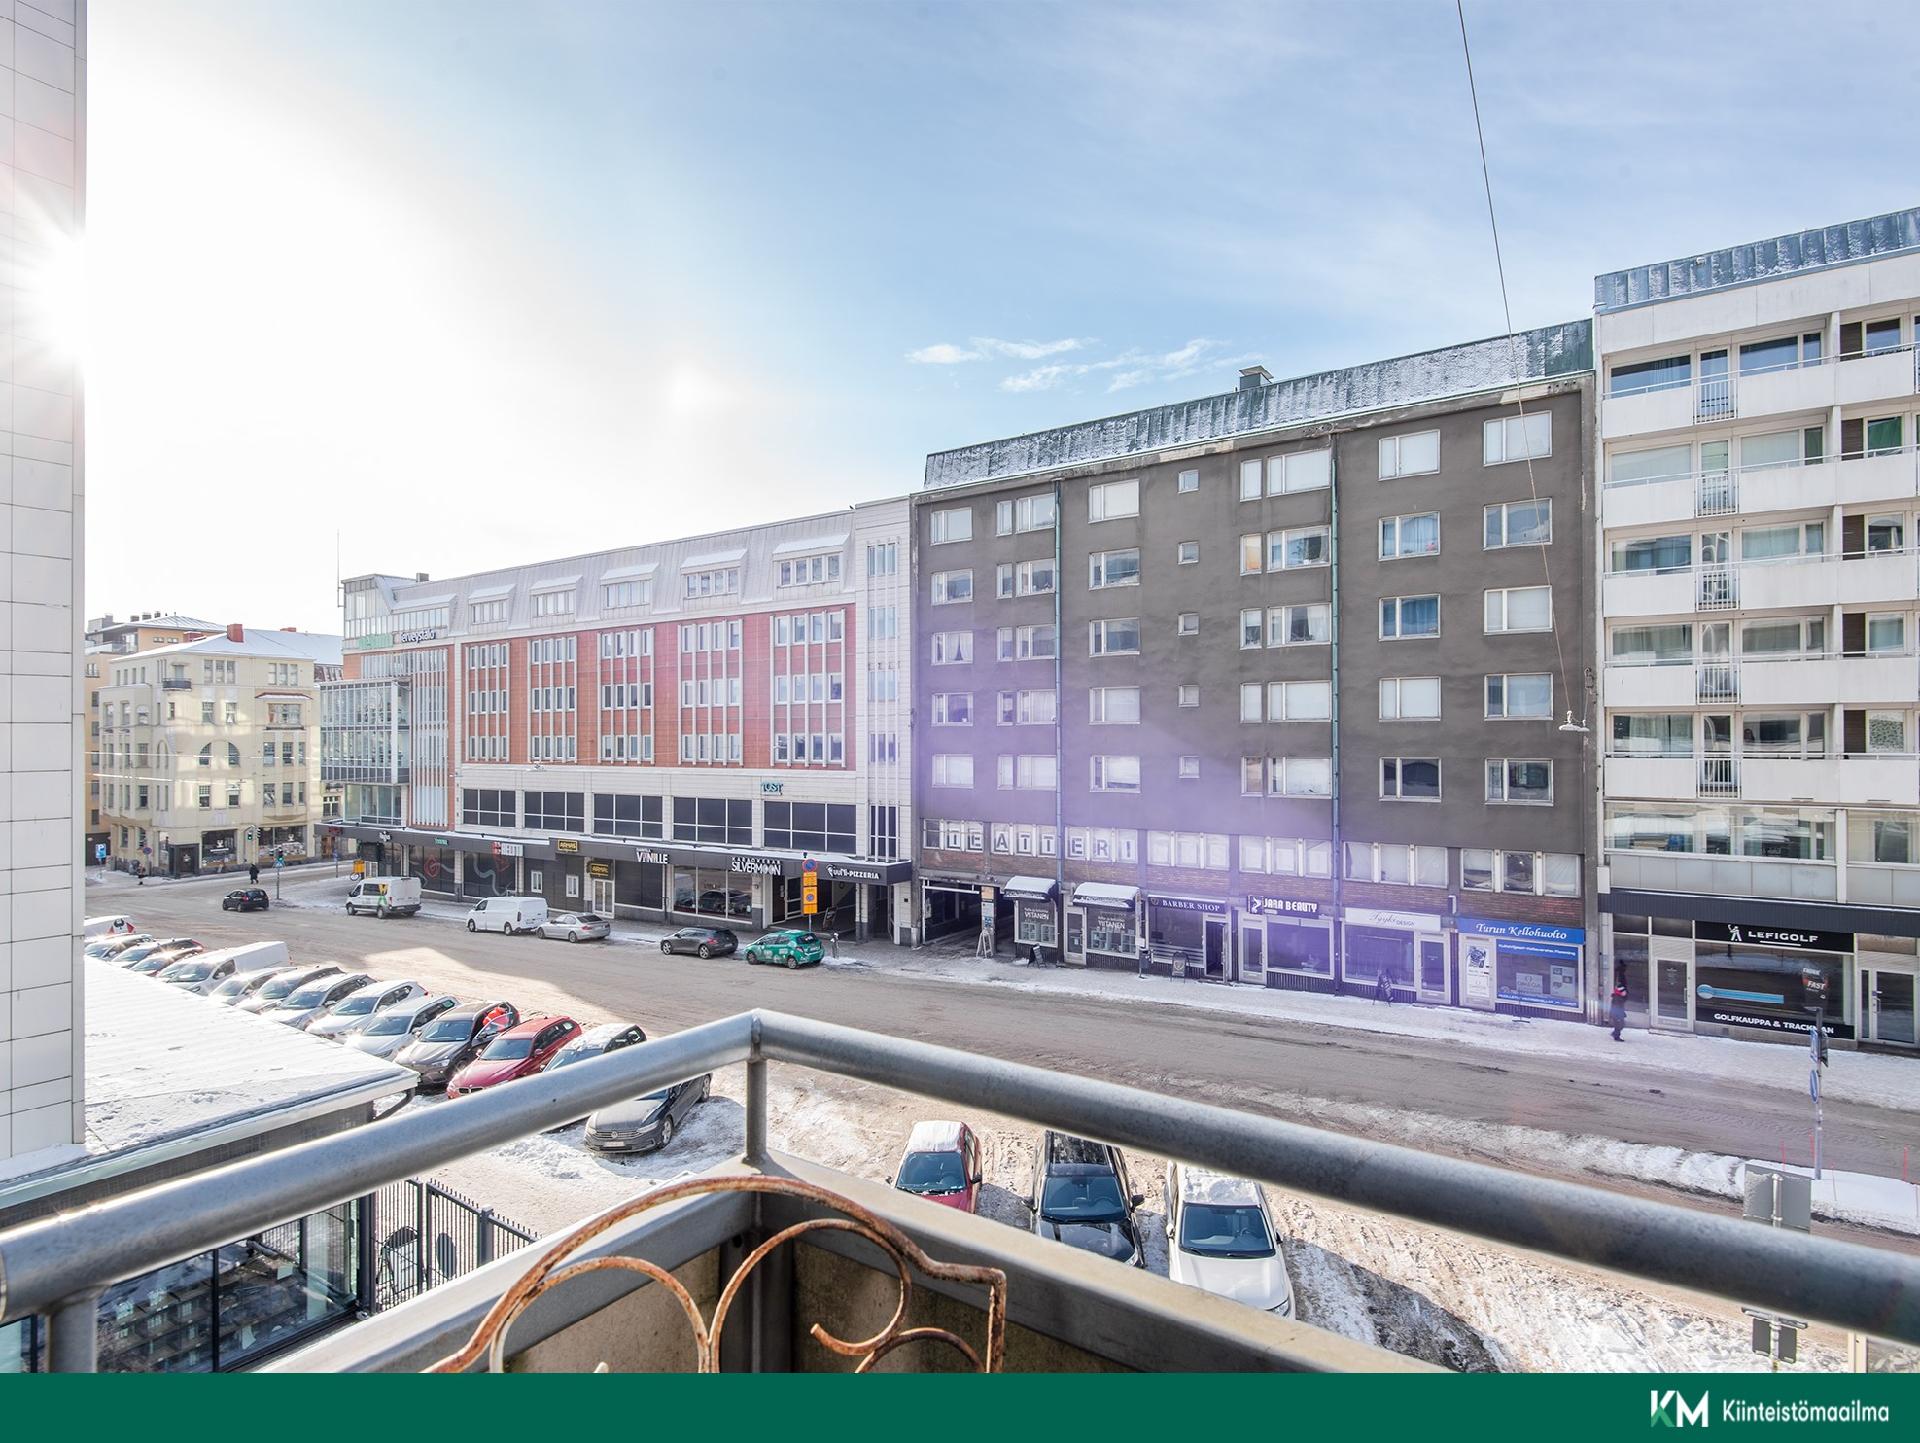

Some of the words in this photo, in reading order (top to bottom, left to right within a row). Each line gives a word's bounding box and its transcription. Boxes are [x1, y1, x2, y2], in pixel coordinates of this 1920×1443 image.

[731, 861, 781, 876] SILVERMOON
[1162, 899, 1195, 910] BARBER
[1197, 903, 1220, 912] SHOP
[1285, 901, 1317, 913] BEAUTY
[1475, 923, 1506, 934] Turun
[1508, 926, 1567, 940] Kellohuolto
[1748, 931, 1818, 943] LEFIGOLF
[1807, 980, 1826, 990] FAST
[1713, 1013, 1772, 1028] GOLFKAUPPA
[1772, 1020, 1781, 1028] &
